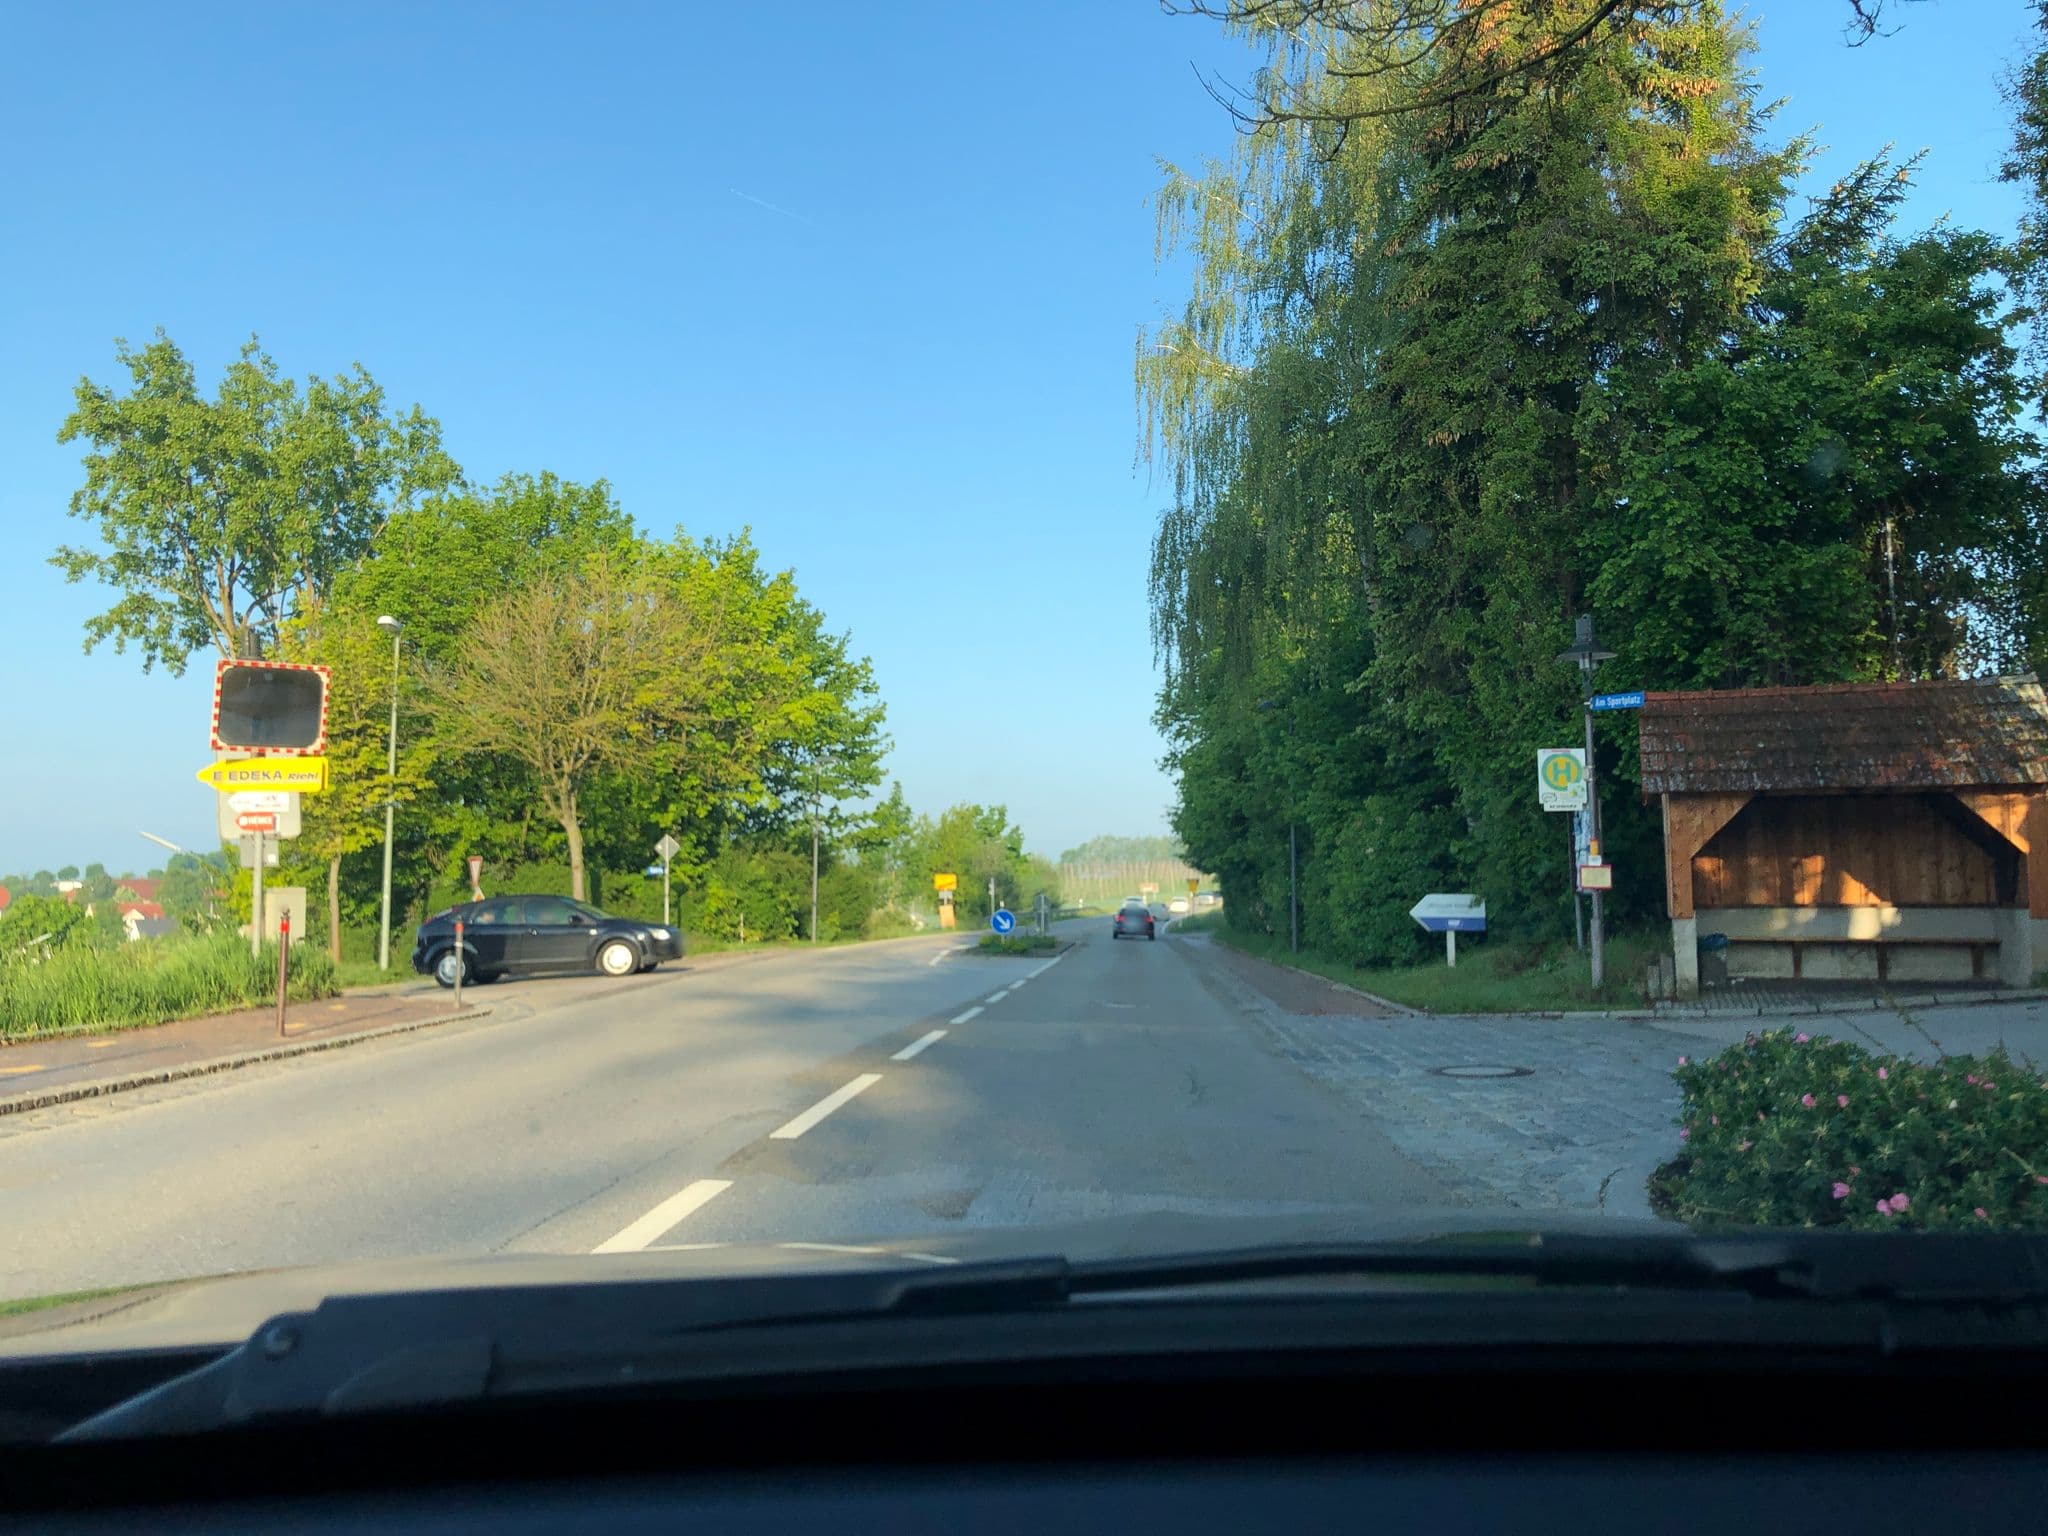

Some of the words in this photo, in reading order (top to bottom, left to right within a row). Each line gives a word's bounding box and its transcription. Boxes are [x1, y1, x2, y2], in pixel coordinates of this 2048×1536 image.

[1595, 698, 1606, 706] Am
[1607, 696, 1640, 708] Sportplatz
[229, 770, 282, 780] EDEKA
[1553, 761, 1571, 782] H
